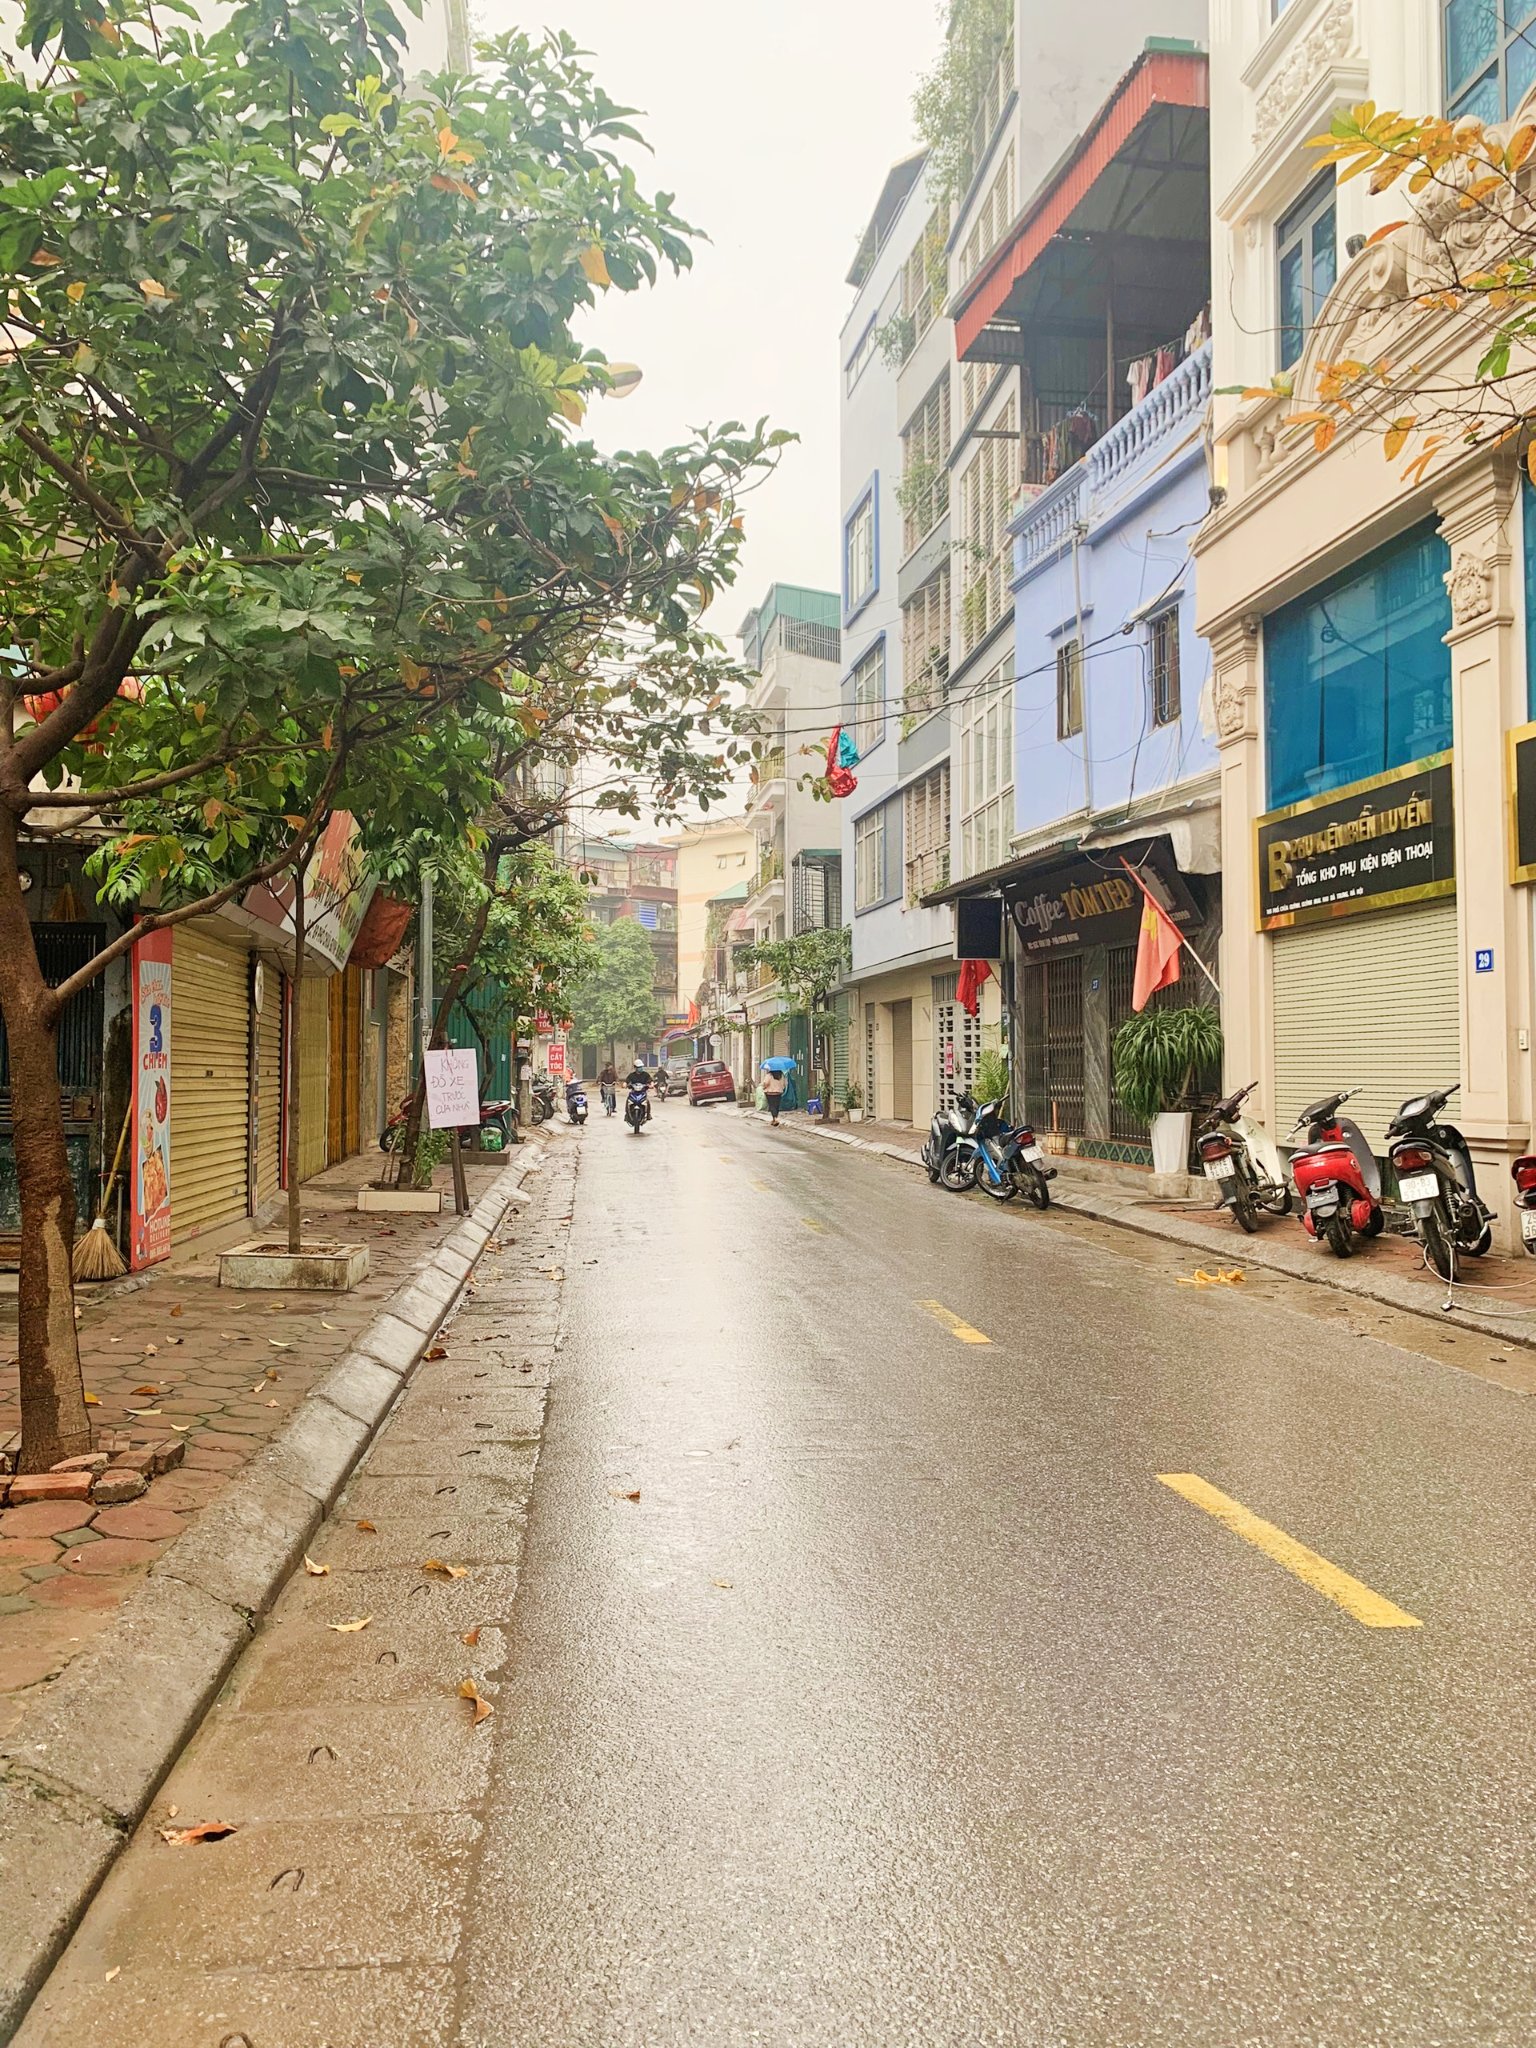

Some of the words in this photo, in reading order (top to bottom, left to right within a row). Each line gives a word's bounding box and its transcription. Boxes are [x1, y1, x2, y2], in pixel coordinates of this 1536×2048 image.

[1320, 866, 1337, 882] KHO
[1340, 860, 1357, 878] PHỤ
[1360, 854, 1379, 875] KIỆN
[1381, 848, 1402, 869] ĐIỆN
[1405, 841, 1433, 860] THOẠI
[1015, 893, 1065, 933] Coffee
[1478, 952, 1490, 969] 29
[150, 1004, 163, 1053] 3
